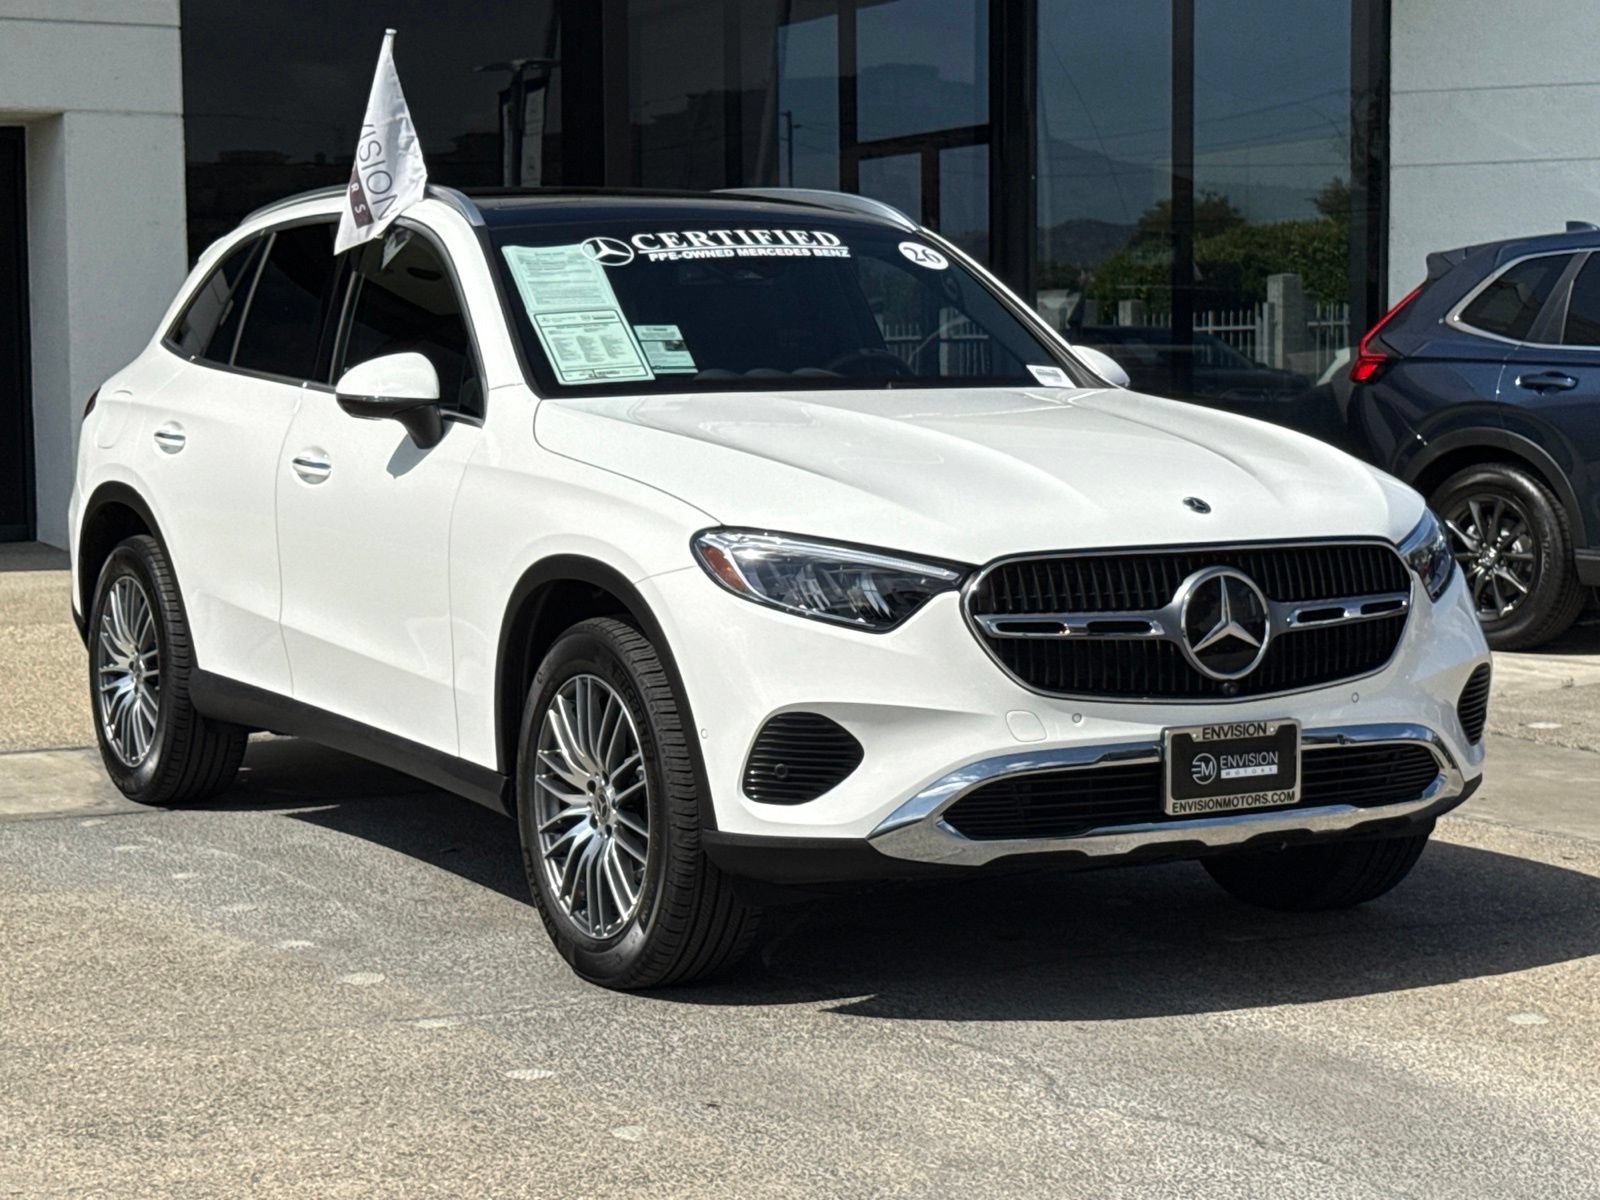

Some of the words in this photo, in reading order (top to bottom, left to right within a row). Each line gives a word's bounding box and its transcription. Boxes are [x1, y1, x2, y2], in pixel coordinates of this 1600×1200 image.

[359, 123, 399, 221] ISION
[631, 229, 841, 250] CERTIFIED
[736, 248, 812, 257] MERCEDES
[903, 245, 942, 264] 26
[1202, 723, 1267, 740] ENVISION
[1220, 751, 1279, 769] ENVISION
[1172, 791, 1296, 813] ENVISIONMOTORS.COM
